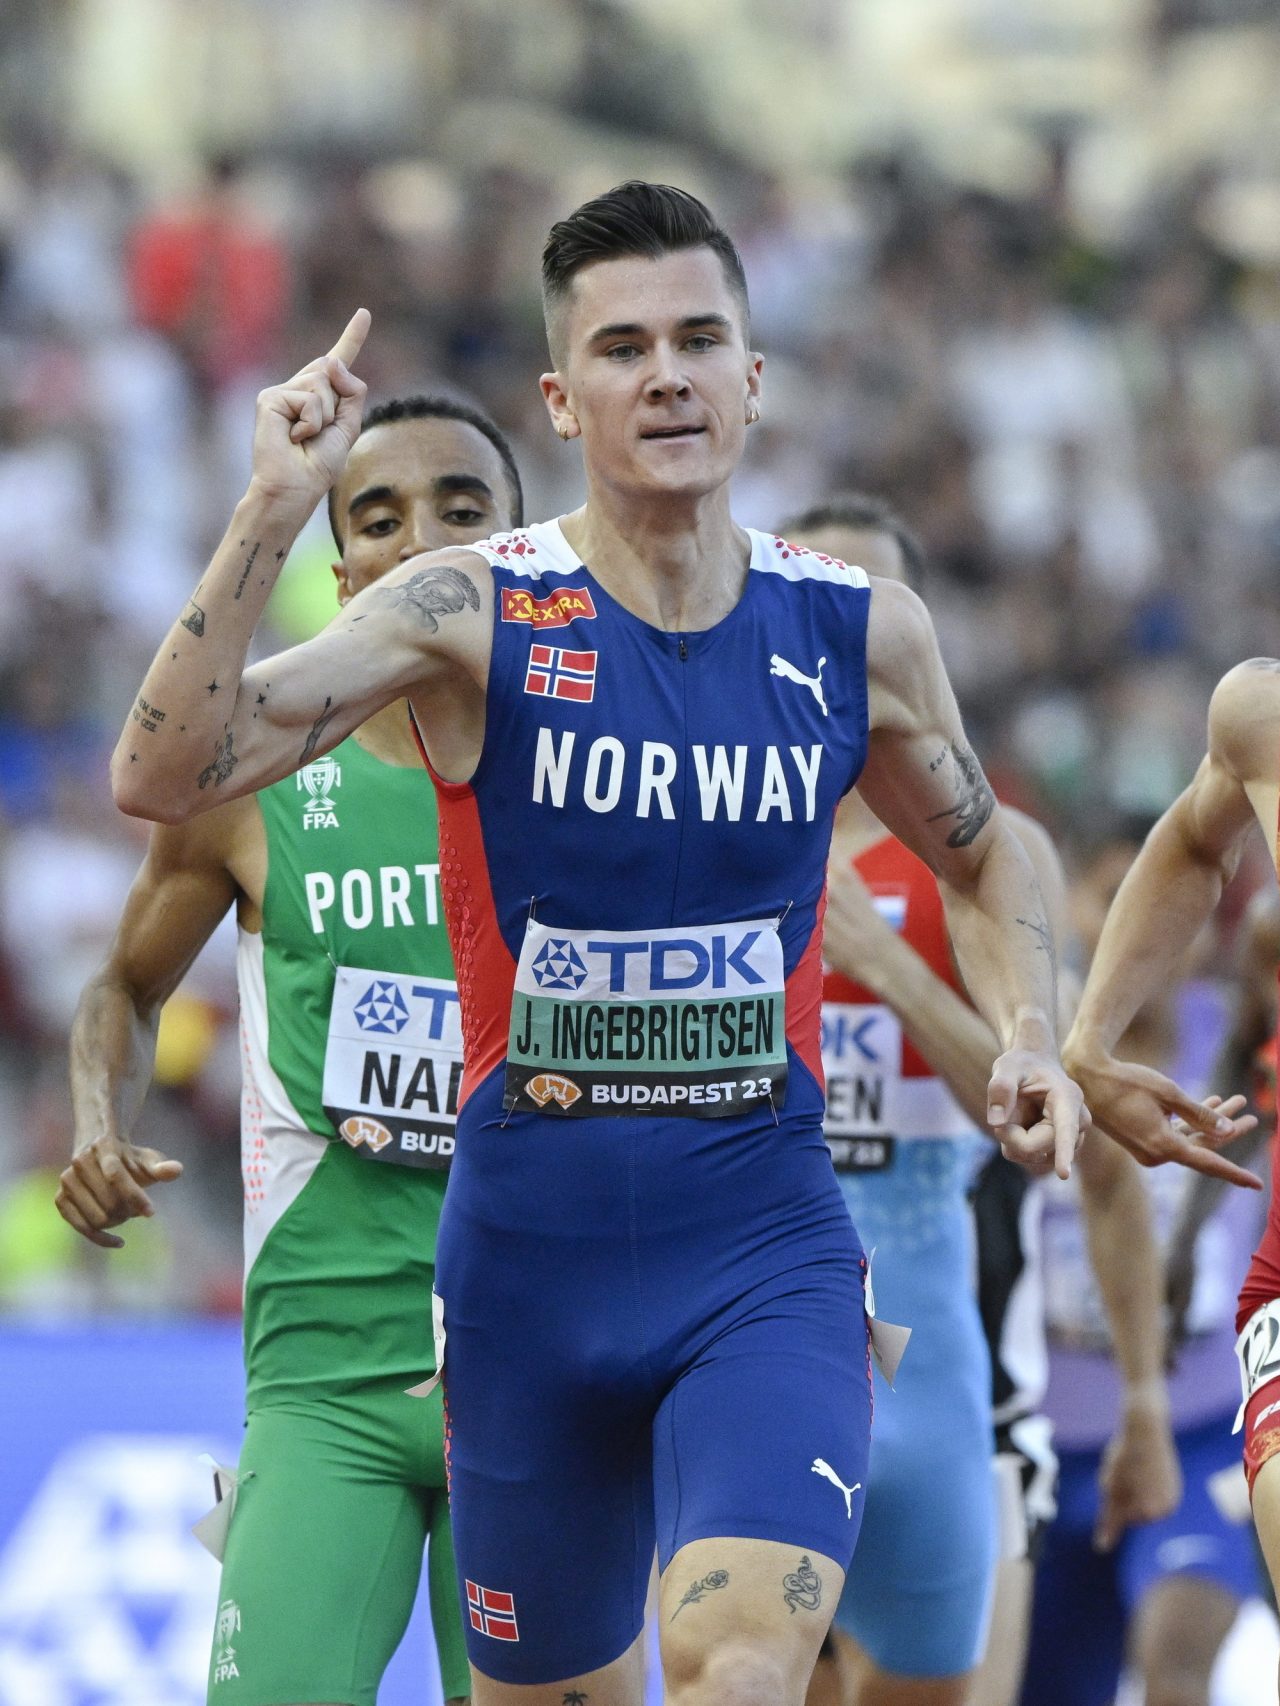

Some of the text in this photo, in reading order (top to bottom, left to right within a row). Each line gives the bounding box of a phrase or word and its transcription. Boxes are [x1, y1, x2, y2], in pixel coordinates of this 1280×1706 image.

[532, 597, 587, 621] EXTRA
[532, 727, 824, 822] NORWAY
[303, 811, 340, 830] FPA
[304, 864, 441, 934] PORT
[587, 931, 767, 993] TDK
[412, 985, 462, 1041] T
[516, 998, 775, 1062] J. INGEBRIGTSEN
[591, 1077, 773, 1105] BUDAPEST 23
[825, 1075, 883, 1122] EN
[400, 1131, 456, 1156] BUD
[214, 1661, 240, 1685] FPA
